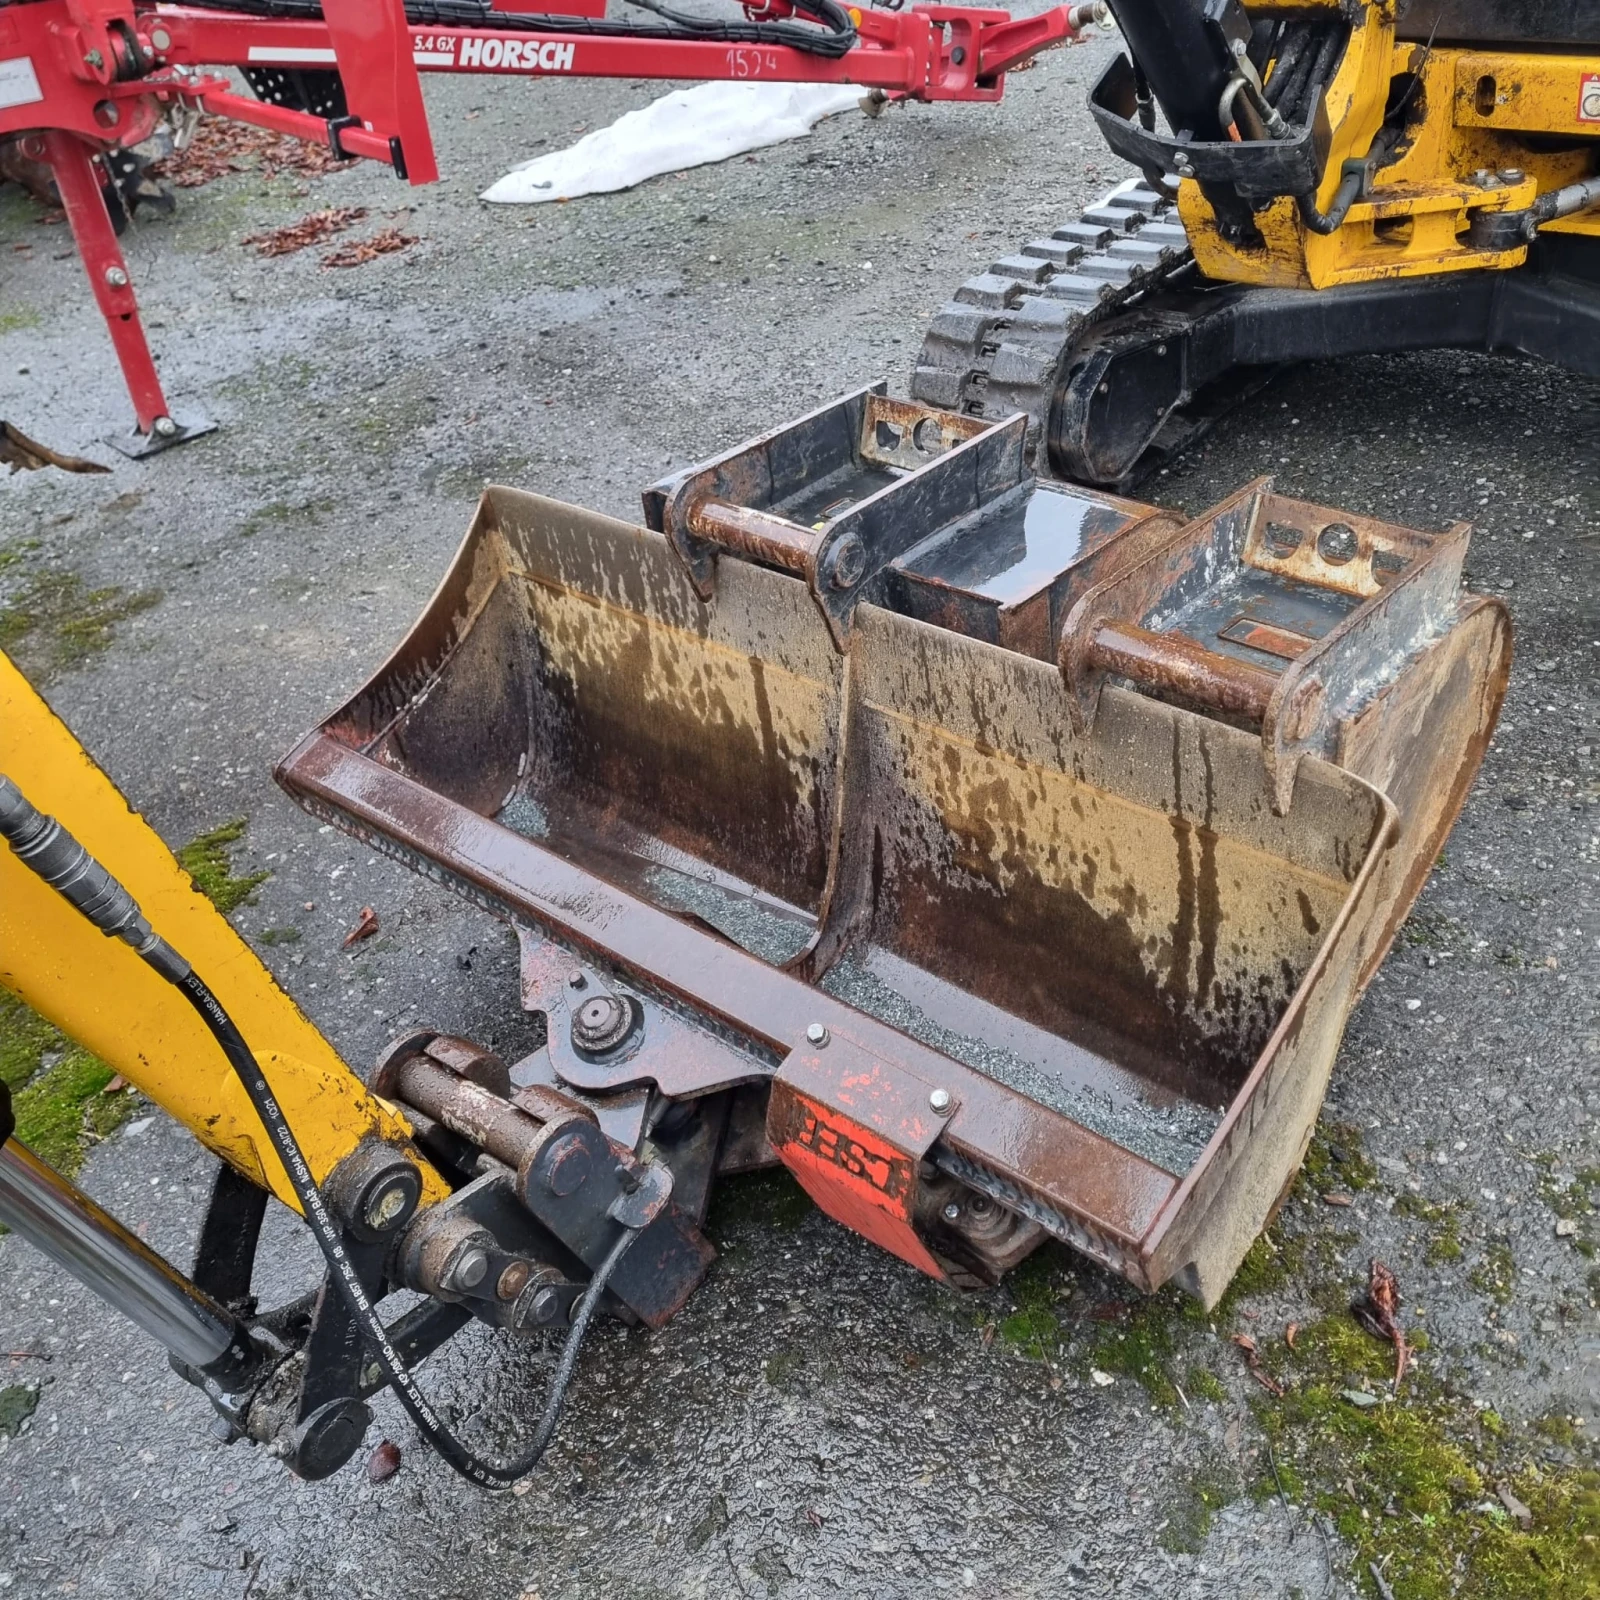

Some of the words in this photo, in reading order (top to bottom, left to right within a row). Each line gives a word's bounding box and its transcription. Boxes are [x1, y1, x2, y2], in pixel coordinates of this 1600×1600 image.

[414, 35, 434, 51] 5.4
[436, 36, 456, 52] GX
[459, 37, 575, 71] HORSCH
[185, 974, 227, 1026] HANSA-FLEX
[263, 1097, 280, 1120] 1Q21
[291, 1155, 310, 1183] MSHA
[305, 1187, 322, 1210] BAR
[315, 1208, 329, 1226] 350
[322, 1224, 336, 1242] WP
[333, 1246, 344, 1258] 08
[340, 1261, 354, 1280] 2SC
[349, 1282, 362, 1299] 857
[356, 1294, 369, 1311] EN
[382, 1345, 395, 1361] NO
[398, 1373, 410, 1387] KP
[407, 1385, 440, 1432] HANSA-FLEX
